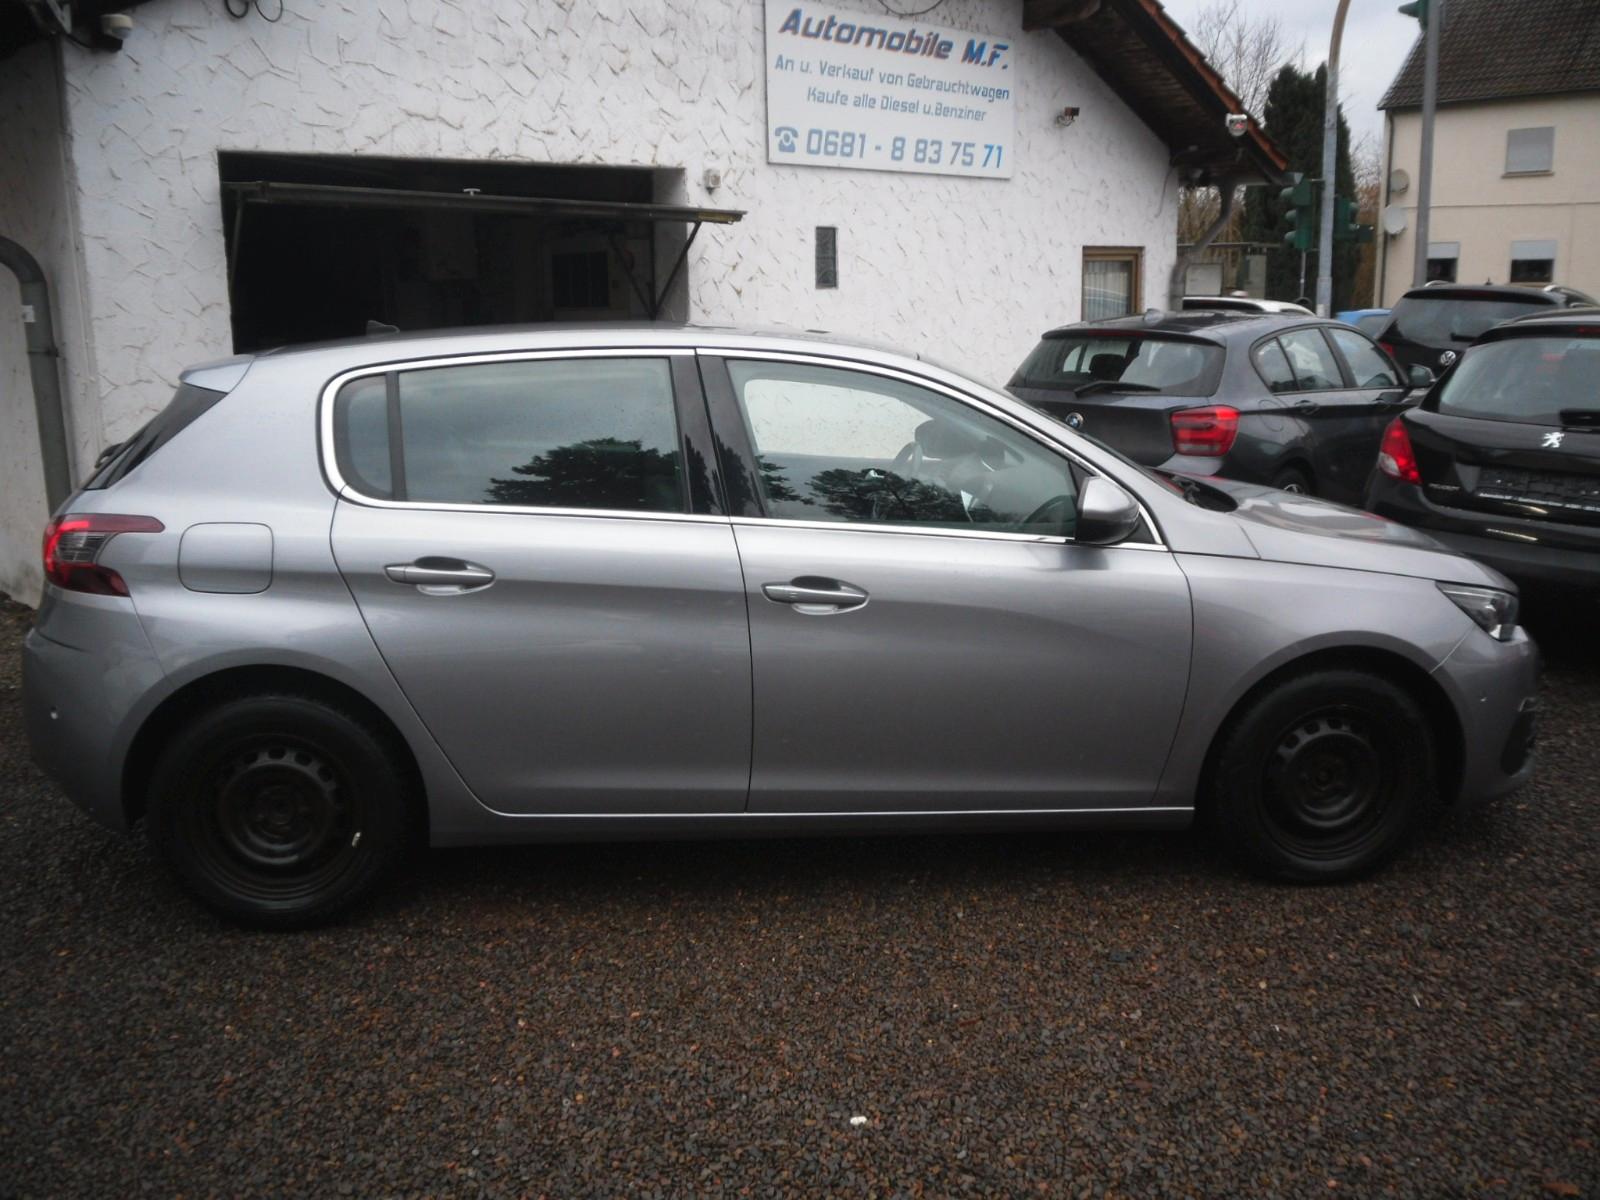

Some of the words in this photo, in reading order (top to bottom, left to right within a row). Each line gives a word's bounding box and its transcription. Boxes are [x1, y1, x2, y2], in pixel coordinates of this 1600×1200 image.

[778, 8, 954, 60] Automobile
[961, 38, 1010, 70] M.F.
[775, 54, 796, 72] An
[800, 60, 813, 75] u.
[819, 59, 875, 82] Verkauf
[879, 70, 904, 86] von
[907, 73, 1010, 103] Gebrauchtwagen
[807, 87, 849, 106] Kaufe
[853, 93, 877, 109] alle
[880, 95, 920, 114] Diesel
[806, 128, 867, 159] 0681
[890, 136, 906, 162] 8
[913, 138, 943, 165] 83
[950, 140, 976, 167] 75
[982, 143, 1003, 169] 71
